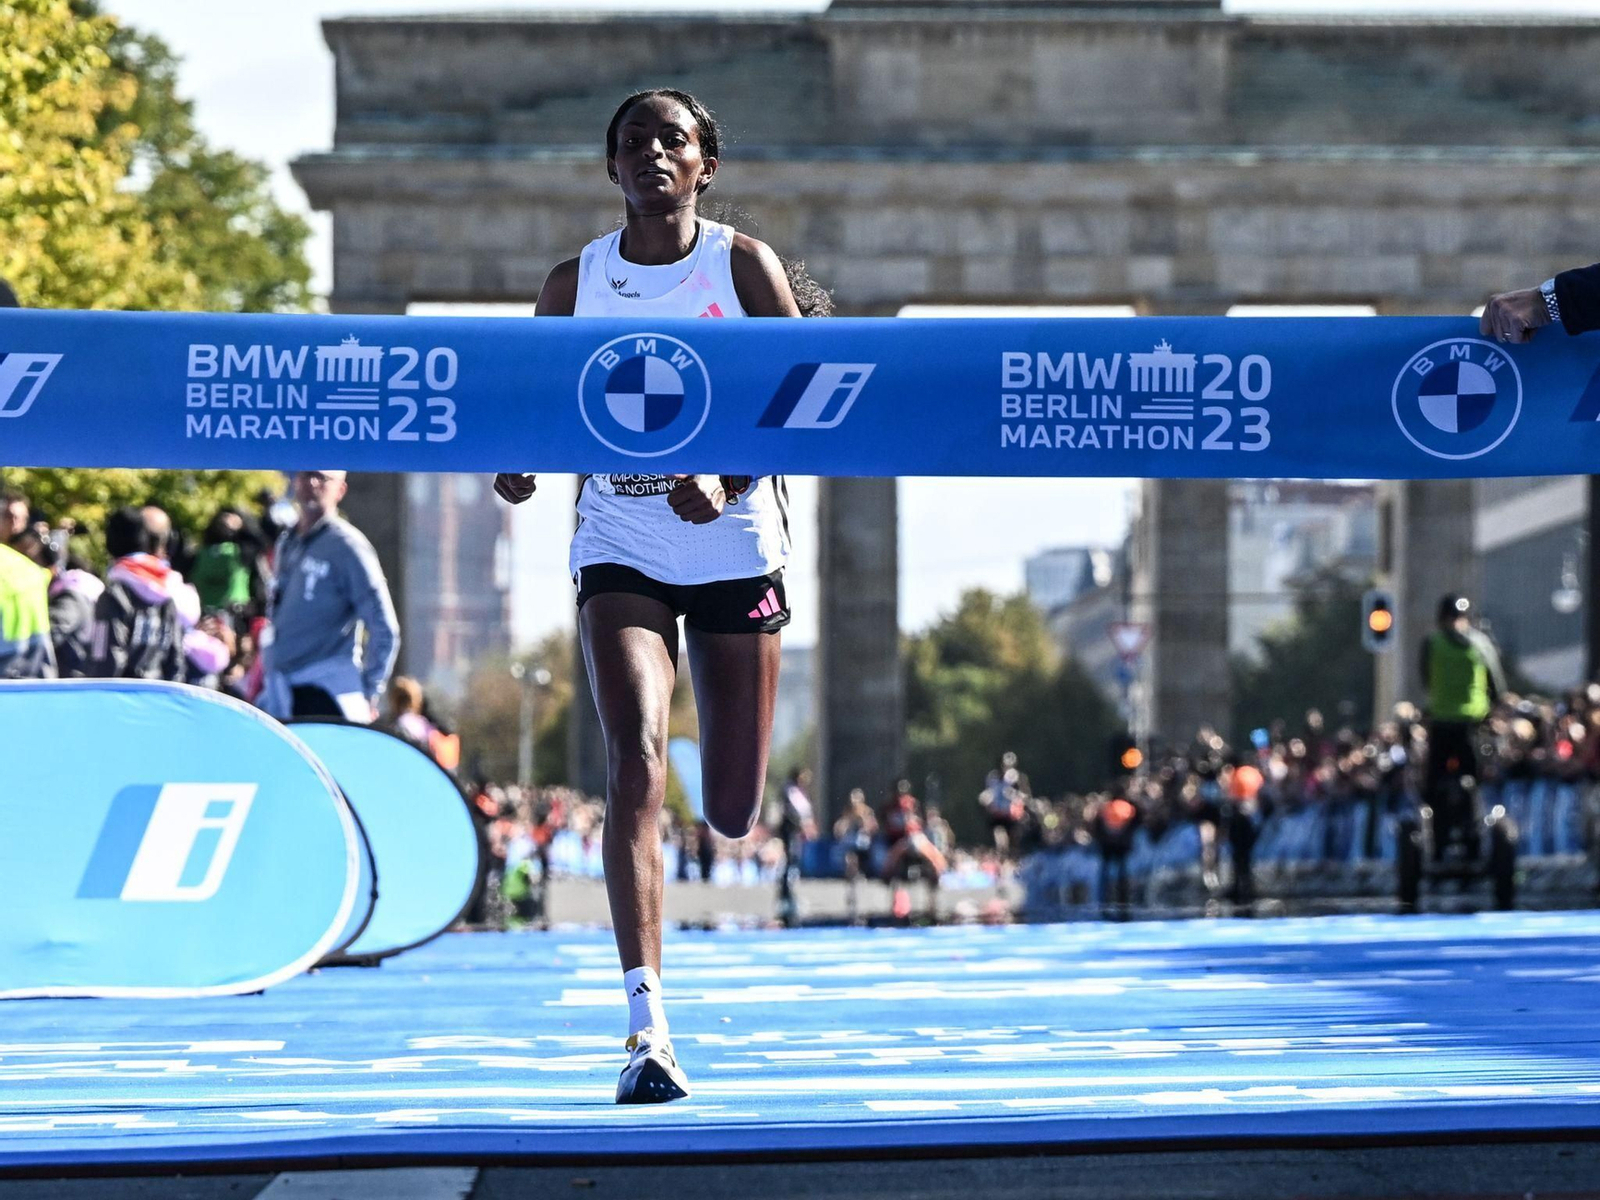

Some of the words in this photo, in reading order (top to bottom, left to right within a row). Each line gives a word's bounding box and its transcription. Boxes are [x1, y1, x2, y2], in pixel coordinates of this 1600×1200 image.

[618, 291, 641, 299] Angels
[187, 344, 309, 379] BMW
[388, 346, 458, 390] 20
[599, 338, 694, 371] BMW
[1002, 351, 1122, 389] BMW
[1411, 344, 1506, 377] BMW
[1202, 354, 1272, 400] 20
[186, 383, 307, 409] BERLIN
[1001, 394, 1122, 419] BERLIN
[186, 414, 380, 441] MARATHON
[387, 396, 457, 442] 23
[1202, 406, 1271, 451] 23
[1001, 424, 1194, 450] MARATHON
